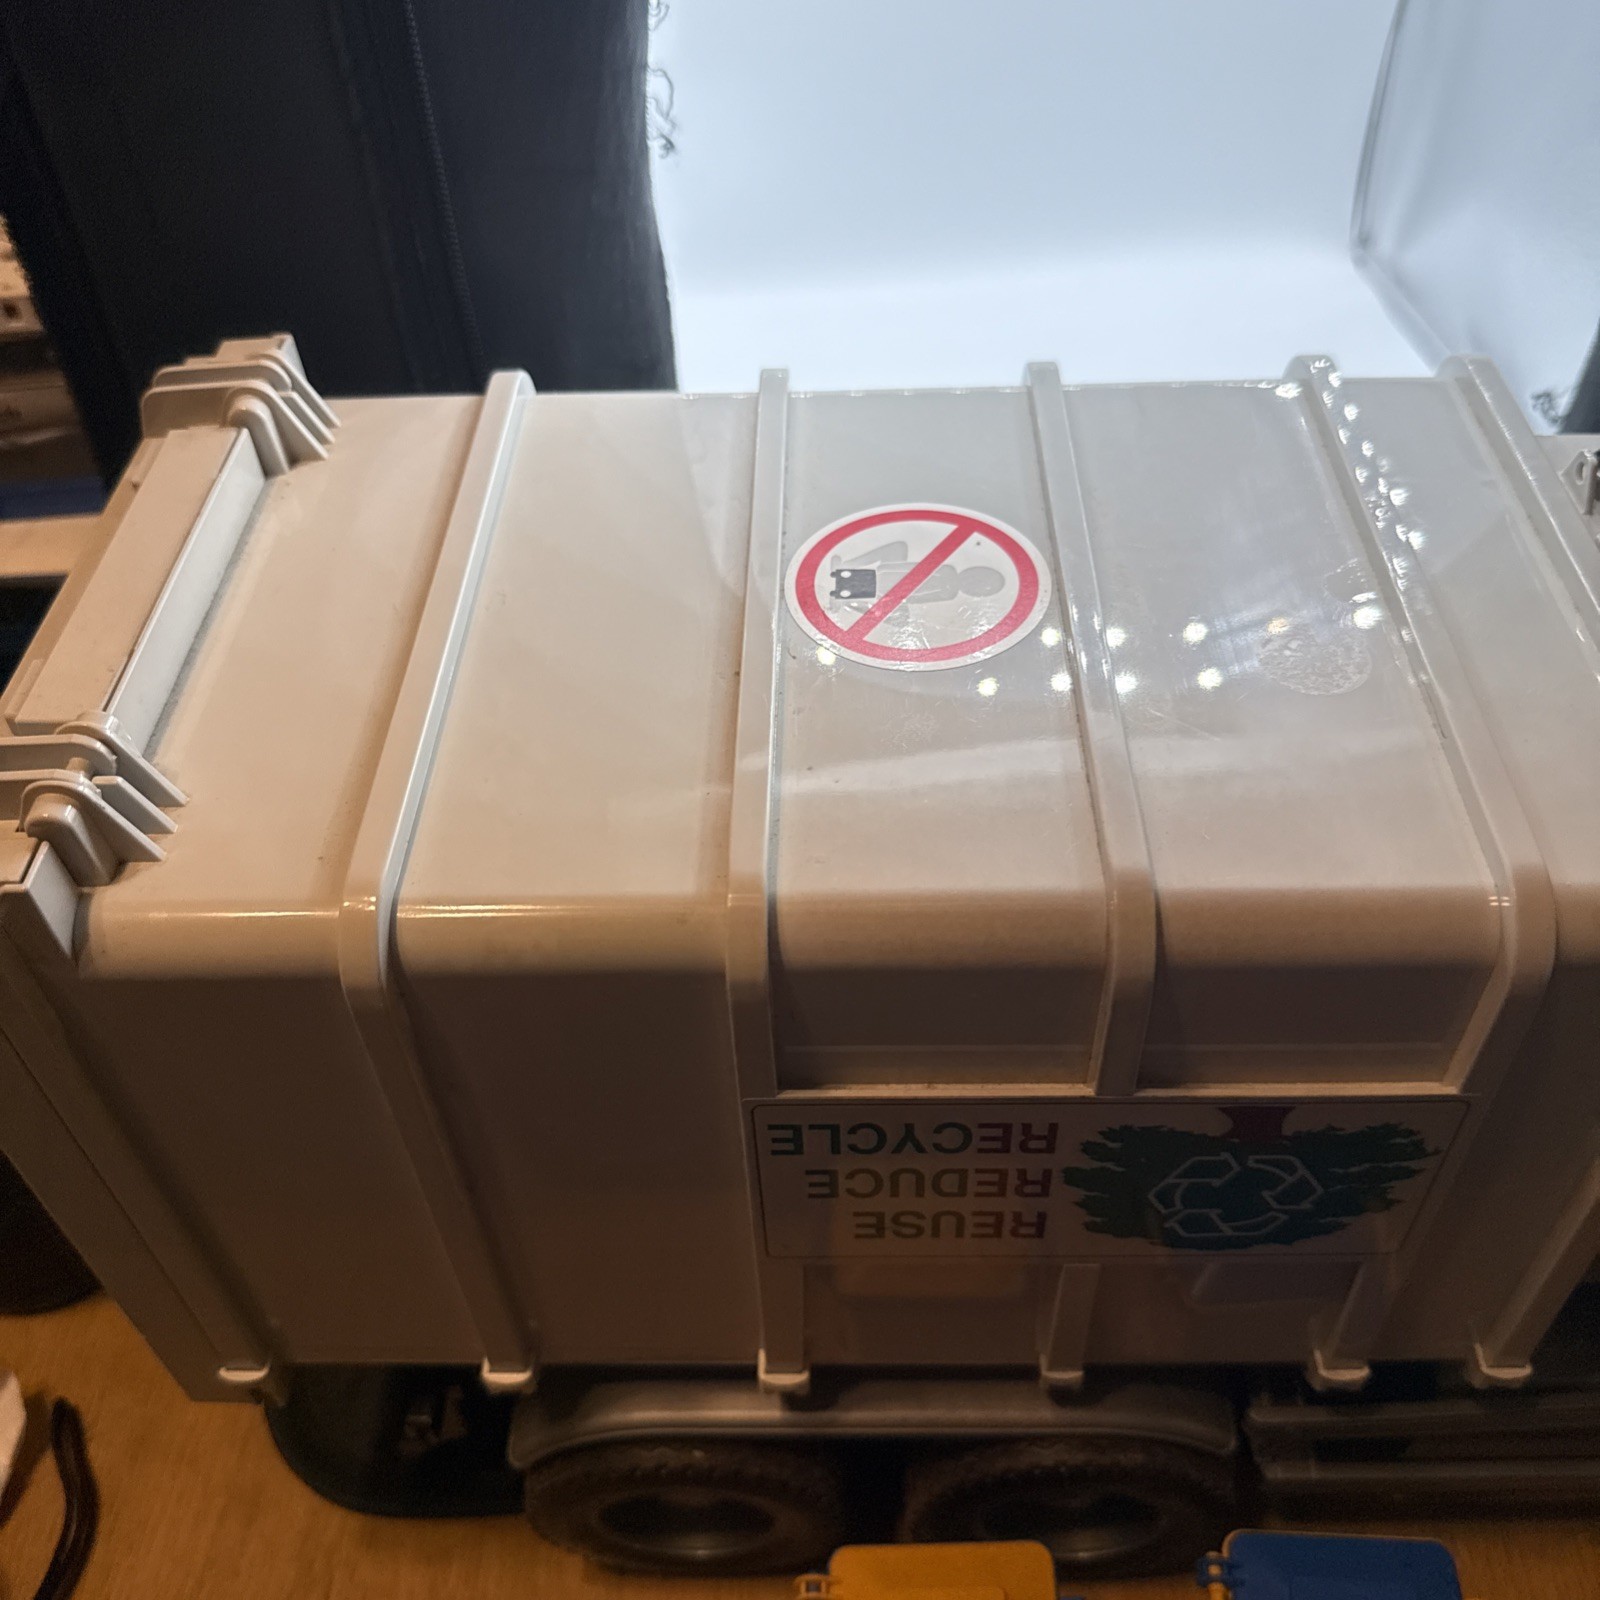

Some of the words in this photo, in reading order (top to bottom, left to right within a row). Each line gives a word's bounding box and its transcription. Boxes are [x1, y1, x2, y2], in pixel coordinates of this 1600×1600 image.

[767, 1122, 1059, 1156] RECYCLE
[805, 1167, 1053, 1199] REDUCE
[852, 1210, 1047, 1239] REUSE
